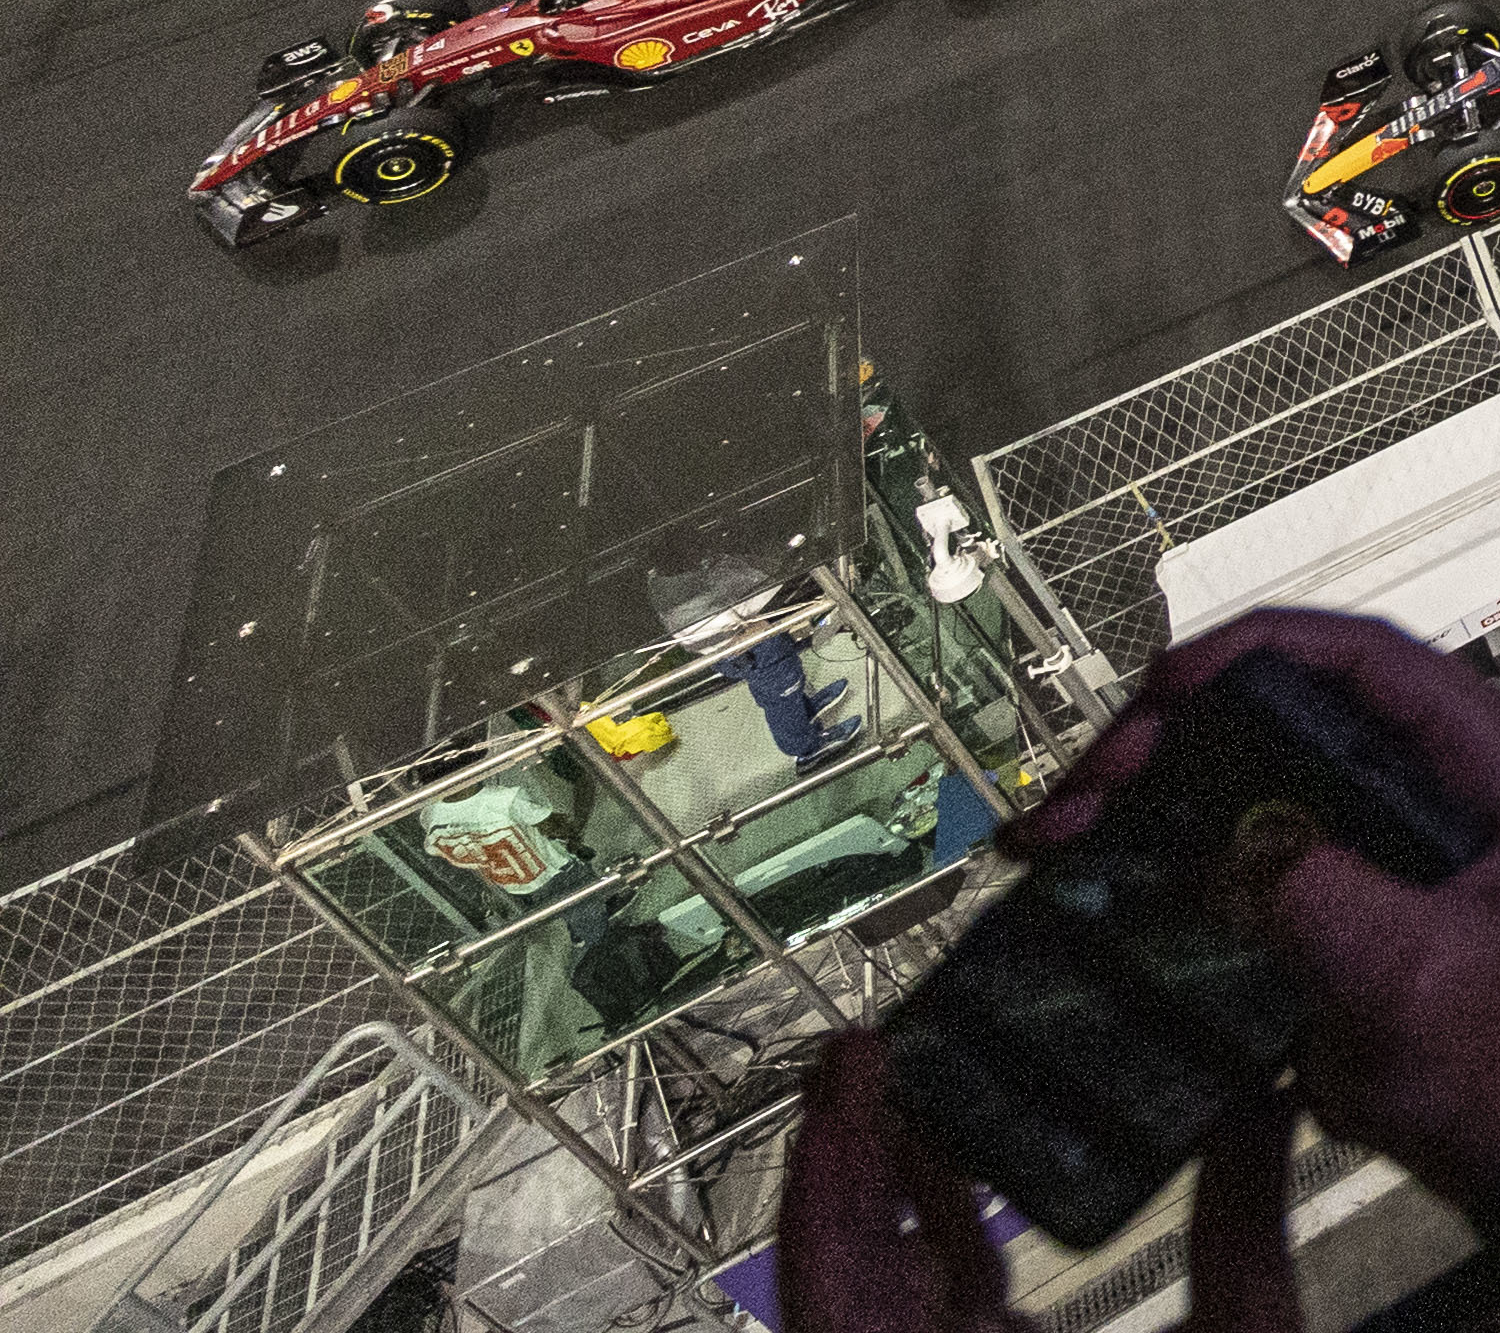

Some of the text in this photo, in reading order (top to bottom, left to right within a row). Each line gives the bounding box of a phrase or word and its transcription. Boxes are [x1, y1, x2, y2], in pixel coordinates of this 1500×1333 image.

[683, 19, 741, 43] CEVA
[283, 41, 322, 64] aws
[1335, 57, 1373, 79] Claro
[1358, 213, 1405, 240] Mobil
